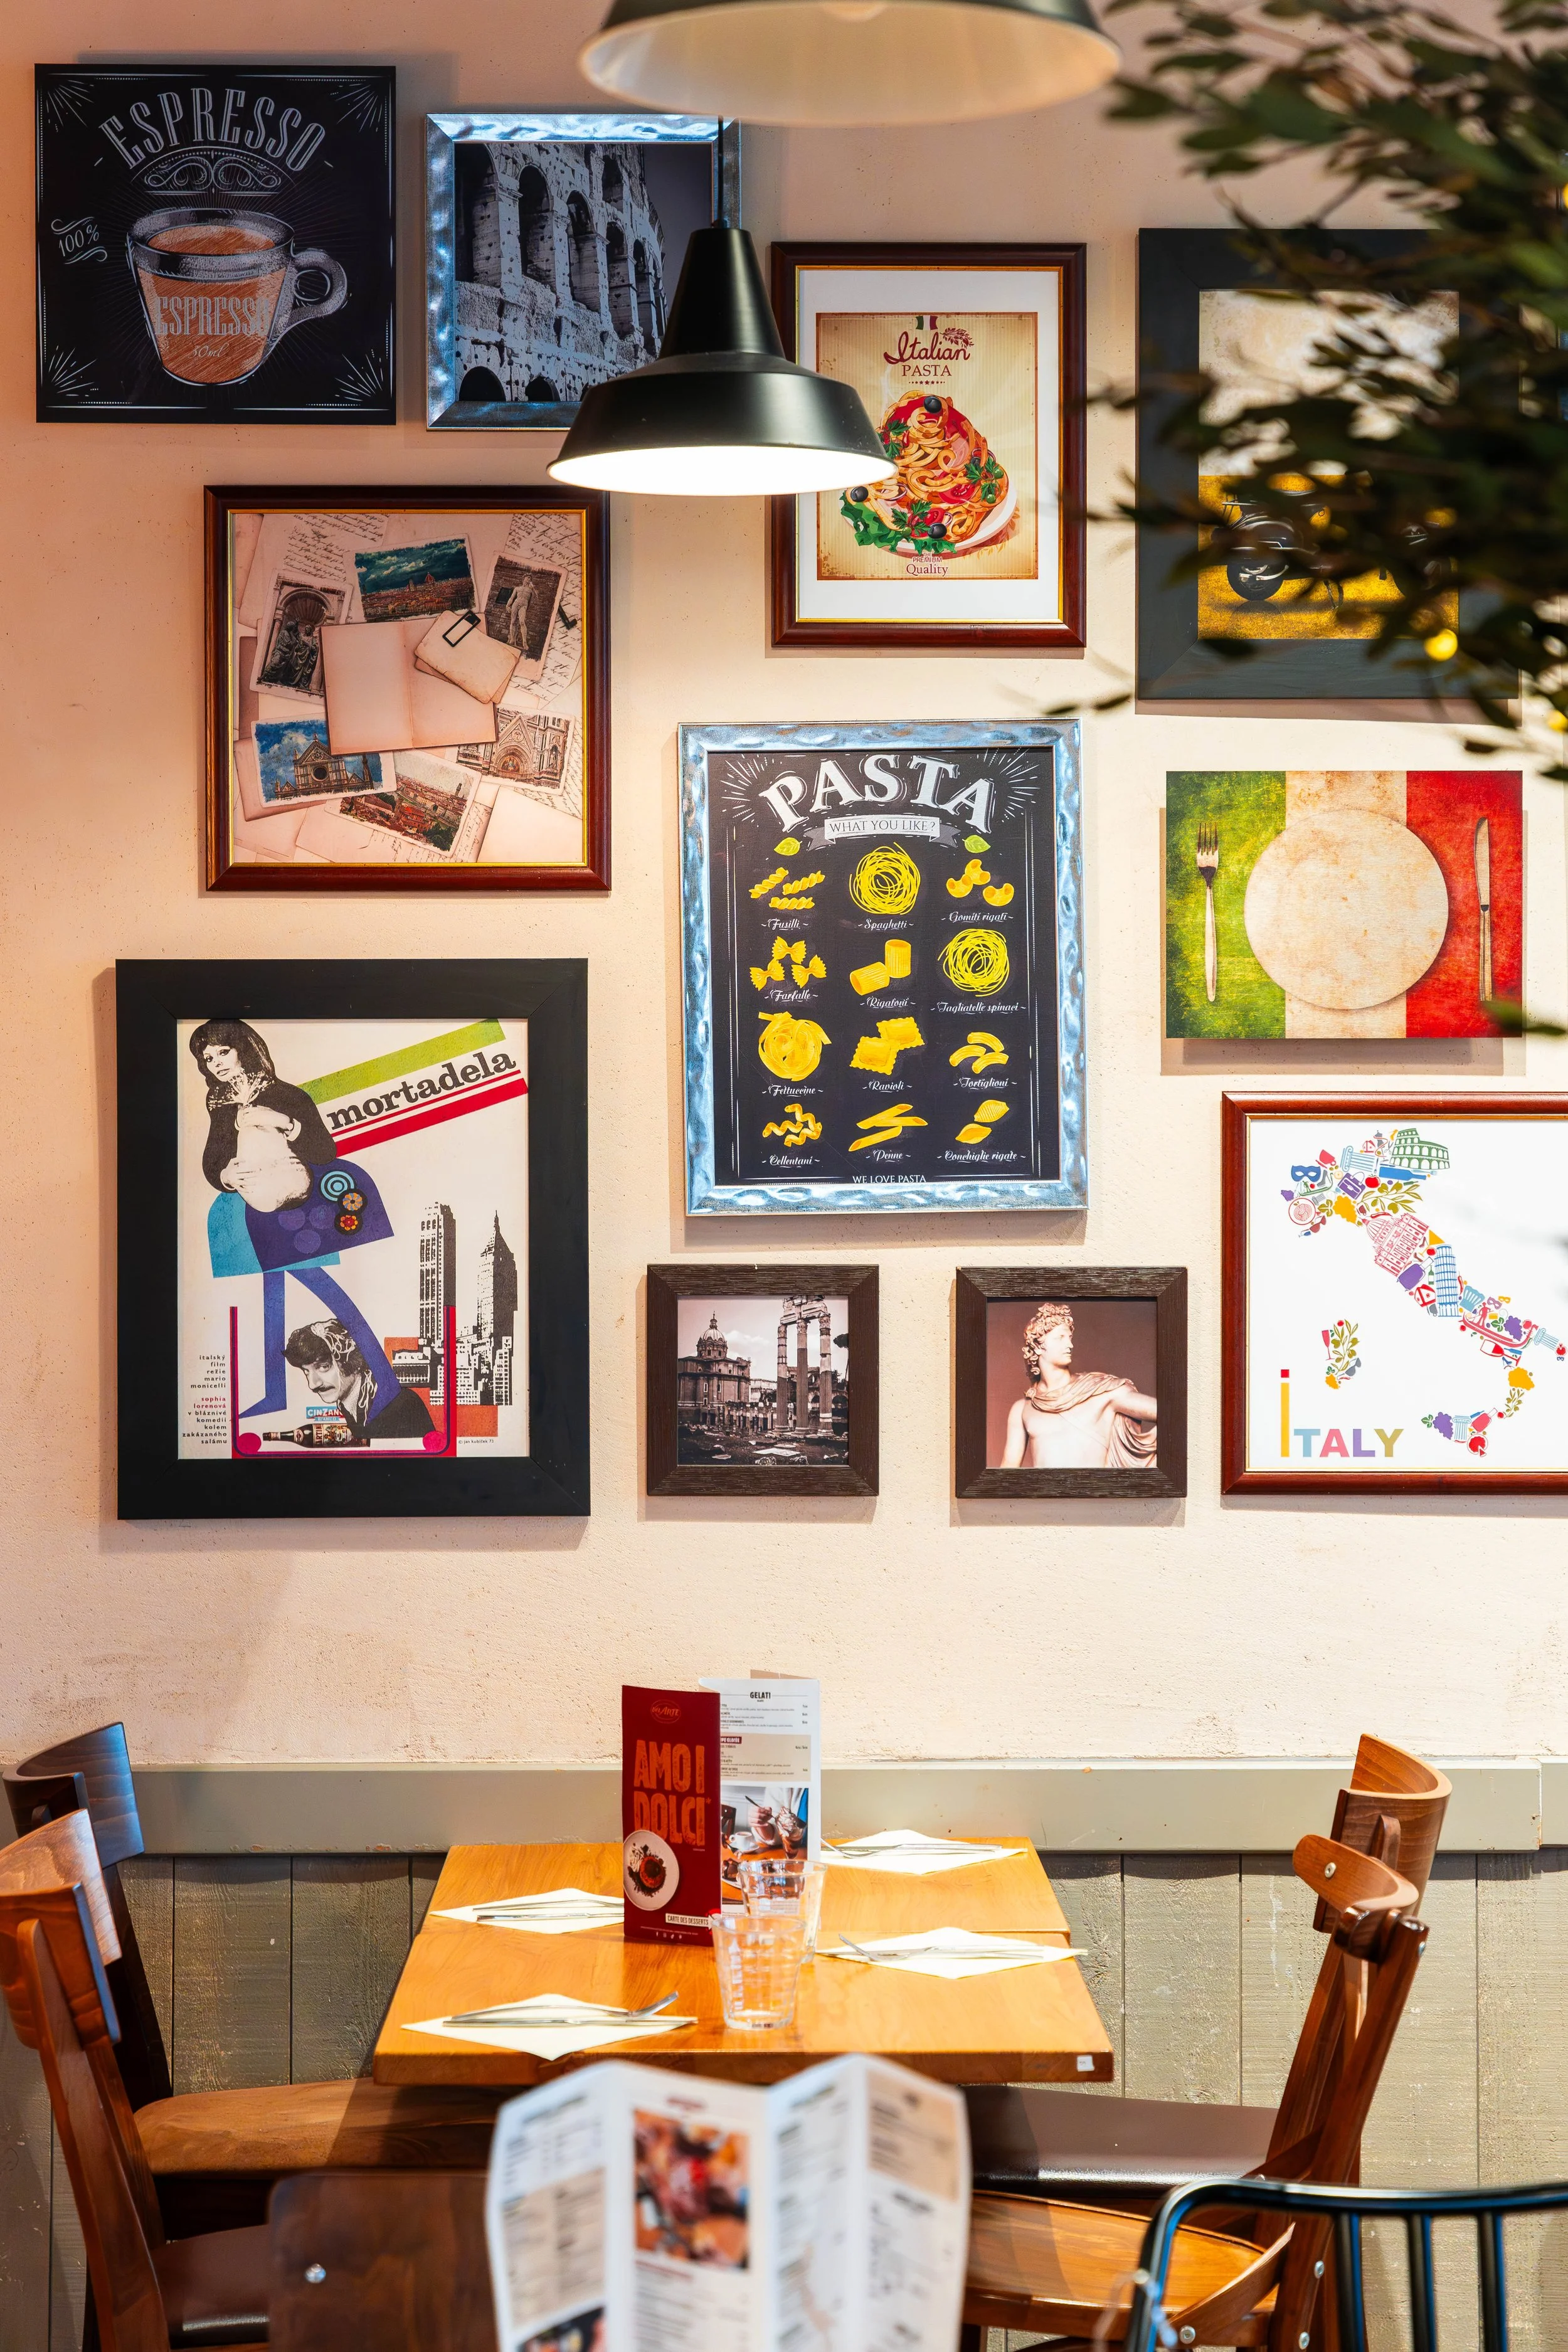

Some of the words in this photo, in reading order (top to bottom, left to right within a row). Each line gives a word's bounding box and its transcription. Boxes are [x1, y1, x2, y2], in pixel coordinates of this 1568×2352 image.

[98, 87, 326, 171] ESPRESSO
[59, 225, 99, 257] 100%
[155, 295, 270, 337] ESPRESSO
[883, 331, 970, 364] Italian
[902, 364, 952, 376] PASTA
[906, 564, 948, 576] Quality
[758, 755, 995, 834] PASTA
[830, 820, 867, 832] WHAT
[871, 820, 898, 830] YOU
[982, 913, 1008, 922] rigati
[768, 918, 800, 930] Fusilli
[864, 918, 908, 931] Spaghetti
[770, 989, 811, 1002] Farfalle
[867, 996, 909, 1009] Rigatoni
[937, 1002, 986, 1014] Tagliatelle
[987, 1002, 1019, 1013] spinaci
[869, 1079, 904, 1091] Ravioli
[959, 1078, 1009, 1089] Tortiglioni
[327, 1051, 516, 1130] mortadela
[768, 1084, 816, 1096] Fettuccine
[770, 1155, 813, 1166] Cellentani
[873, 1149, 903, 1162] Penne
[945, 1150, 990, 1162] Conchiglie
[992, 1151, 1017, 1162] rigate
[852, 1175, 867, 1184] WE
[870, 1175, 895, 1184] LOVE
[898, 1175, 927, 1183] PASTA
[633, 1739, 691, 1793] AMO
[667, 1915, 680, 1923] CARTE
[688, 1917, 709, 1926] DESSERTS
